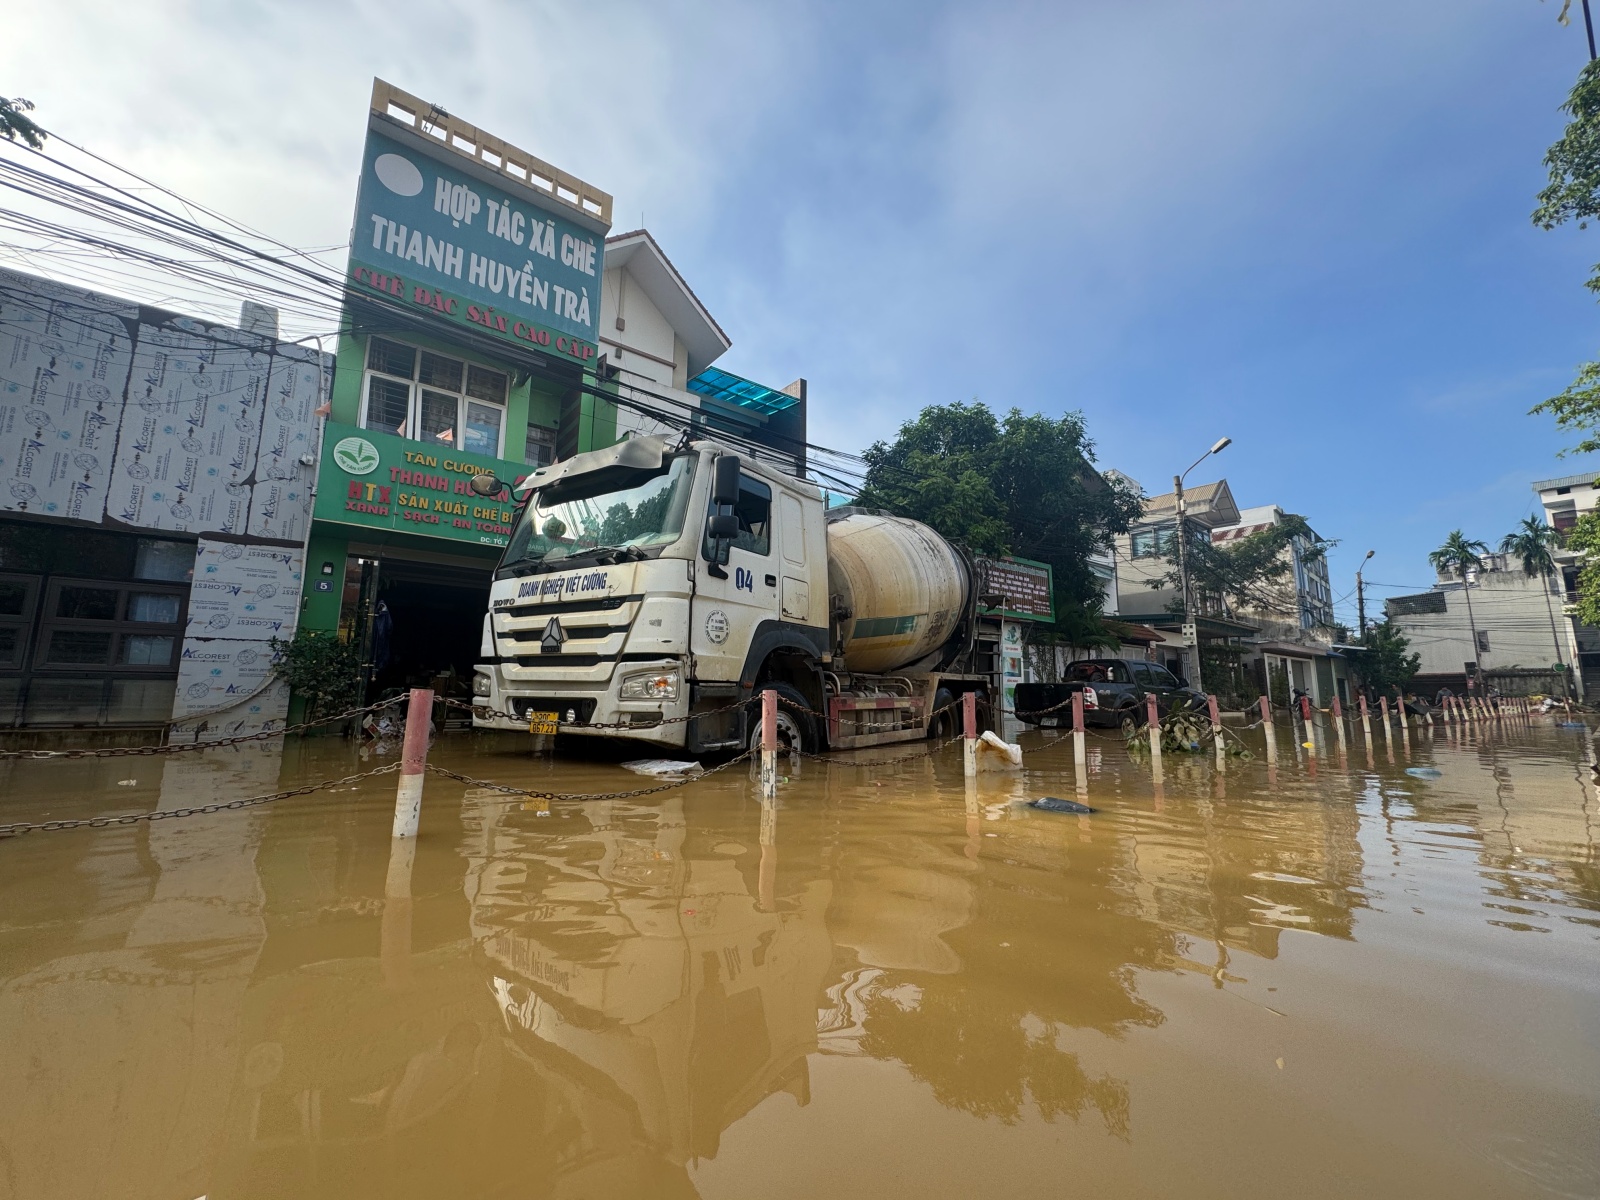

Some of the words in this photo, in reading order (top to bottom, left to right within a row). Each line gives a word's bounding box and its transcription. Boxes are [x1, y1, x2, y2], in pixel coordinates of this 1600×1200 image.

[433, 176, 481, 228] HỢP
[486, 199, 525, 246] TÁC
[528, 218, 556, 261] XÃ
[560, 233, 597, 277] CHÈ
[371, 213, 464, 279] THANH
[468, 252, 549, 311] HUYỀN
[552, 284, 591, 327] TRÀ
[353, 266, 405, 298] CHÈ
[413, 286, 458, 316] ĐẶC
[466, 305, 509, 333] SẢN
[513, 321, 551, 347] CAO
[556, 335, 595, 362] CẤP
[98, 344, 117, 380] ALCOREST
[145, 352, 163, 387] ALCOREST
[37, 368, 58, 406] ALCOREST
[279, 366, 294, 397] ALCOREST
[185, 393, 204, 427] ALCOREST
[85, 411, 106, 449] ALCOREST
[132, 417, 151, 452] ALCOREST
[270, 425, 286, 457] ALCOREST
[22, 439, 45, 478] ALCOREST
[229, 436, 246, 470] ALCOREST
[404, 451, 438, 468] TÂN
[175, 457, 194, 492] ALCOREST
[389, 466, 449, 493] THANH
[454, 480, 509, 503] HUN
[119, 485, 140, 521] ALCOREST
[261, 485, 278, 518] ALCOREST
[347, 480, 392, 504] HTX
[398, 491, 429, 511] SẢN
[433, 500, 469, 517] XUẤT
[473, 506, 499, 521] CHẾ
[219, 500, 237, 533] ALCOREST
[345, 500, 389, 516] XANH
[403, 510, 440, 524] SẠCH
[452, 518, 472, 530] AN
[475, 519, 511, 535] TOÀN
[248, 551, 292, 564] ALCOREST
[194, 583, 242, 596] ALCOREST
[320, 582, 328, 590] 5
[518, 581, 541, 598] DOANH
[540, 575, 565, 597] NGHIỆP
[565, 573, 582, 596] VIỆT
[735, 566, 753, 593] 04
[237, 620, 282, 632] ALCOREST
[182, 648, 231, 660] ALCOREST
[225, 683, 272, 695] ALCOEST
